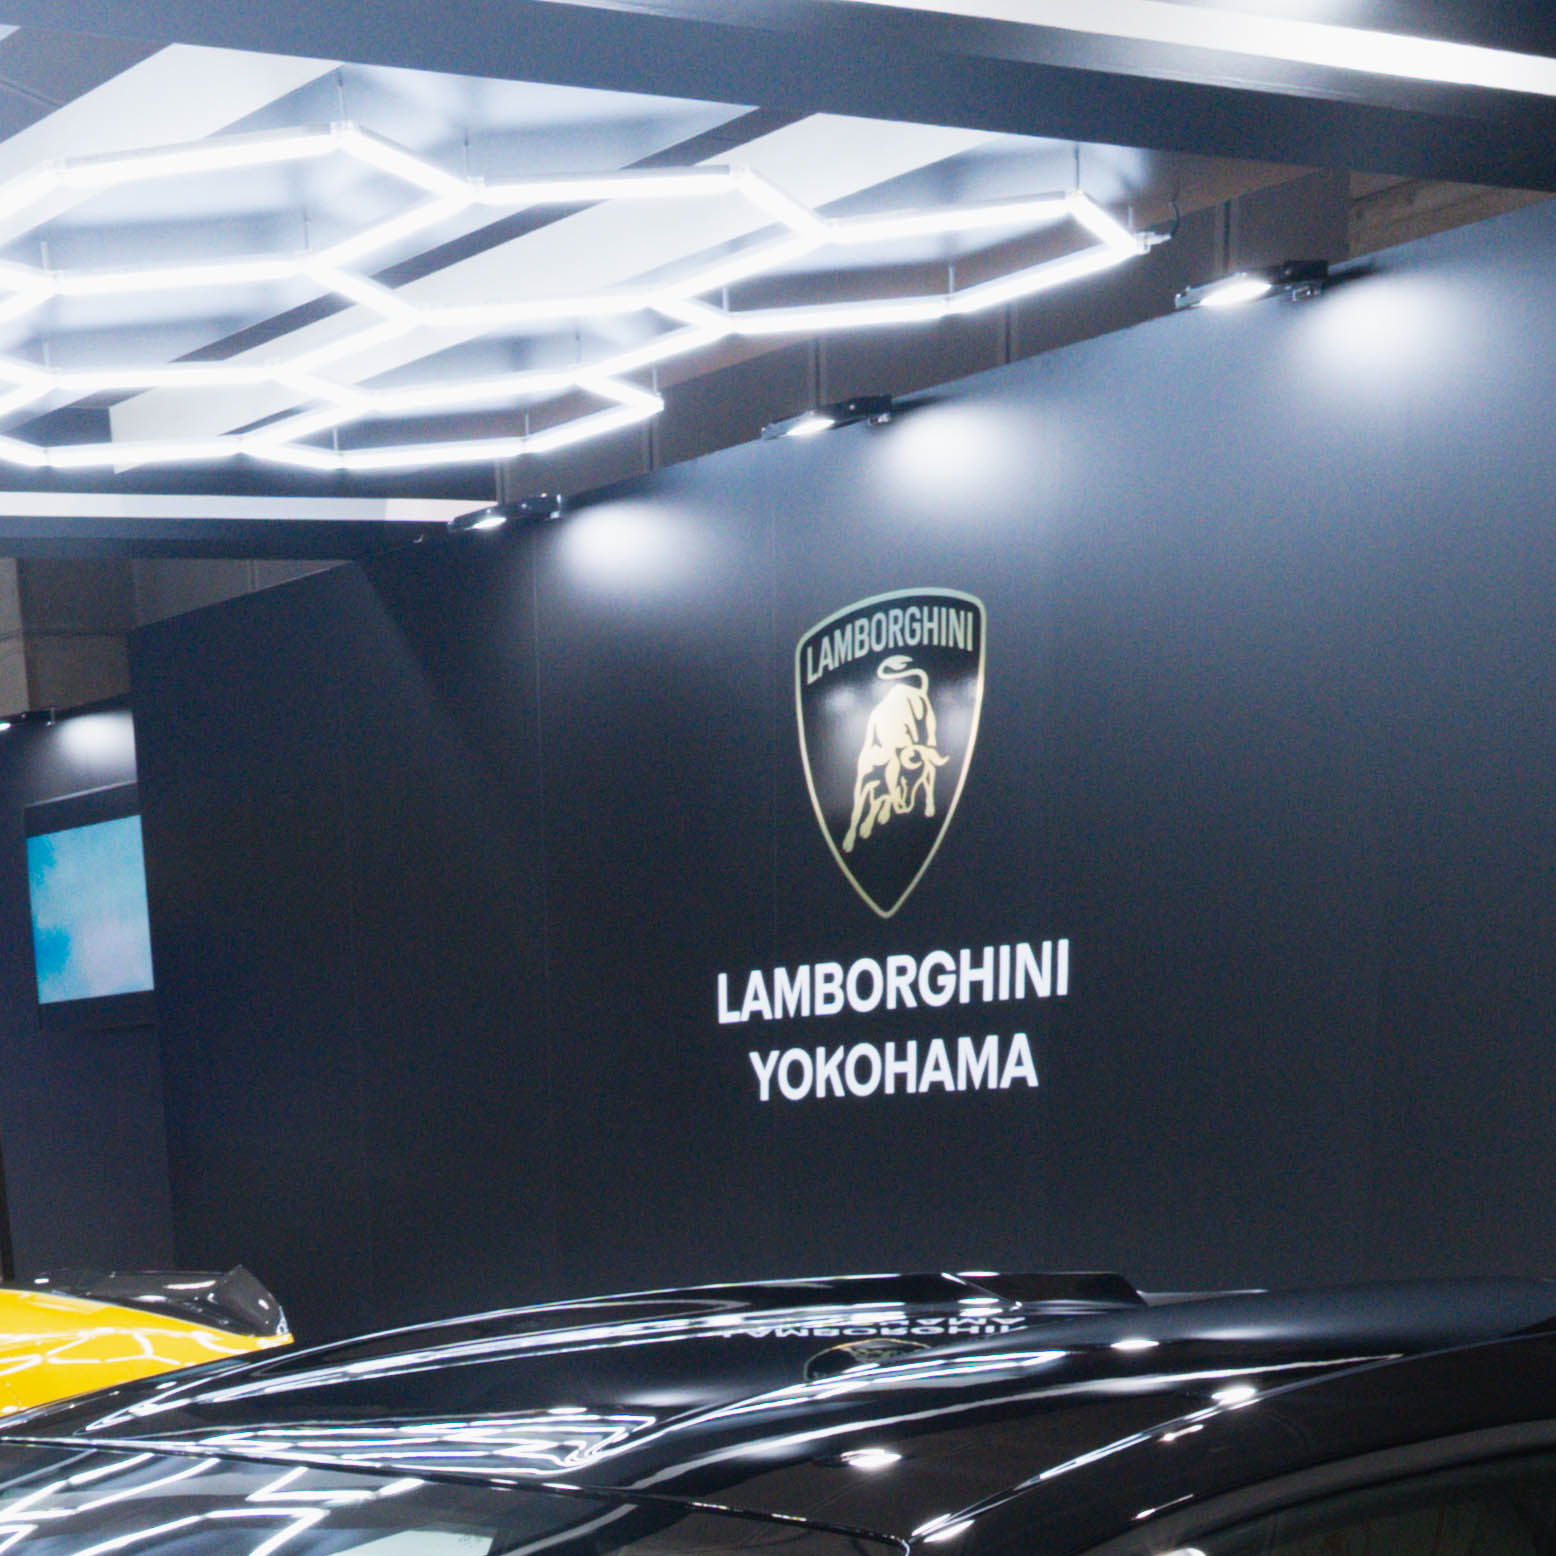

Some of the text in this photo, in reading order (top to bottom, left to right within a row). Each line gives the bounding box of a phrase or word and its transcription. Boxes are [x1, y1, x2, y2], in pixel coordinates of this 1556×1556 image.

[806, 605, 974, 685] LAMBORGHINI
[716, 939, 1070, 1024] LAMBORGHINI
[749, 1032, 1039, 1101] YOKOHAMA
